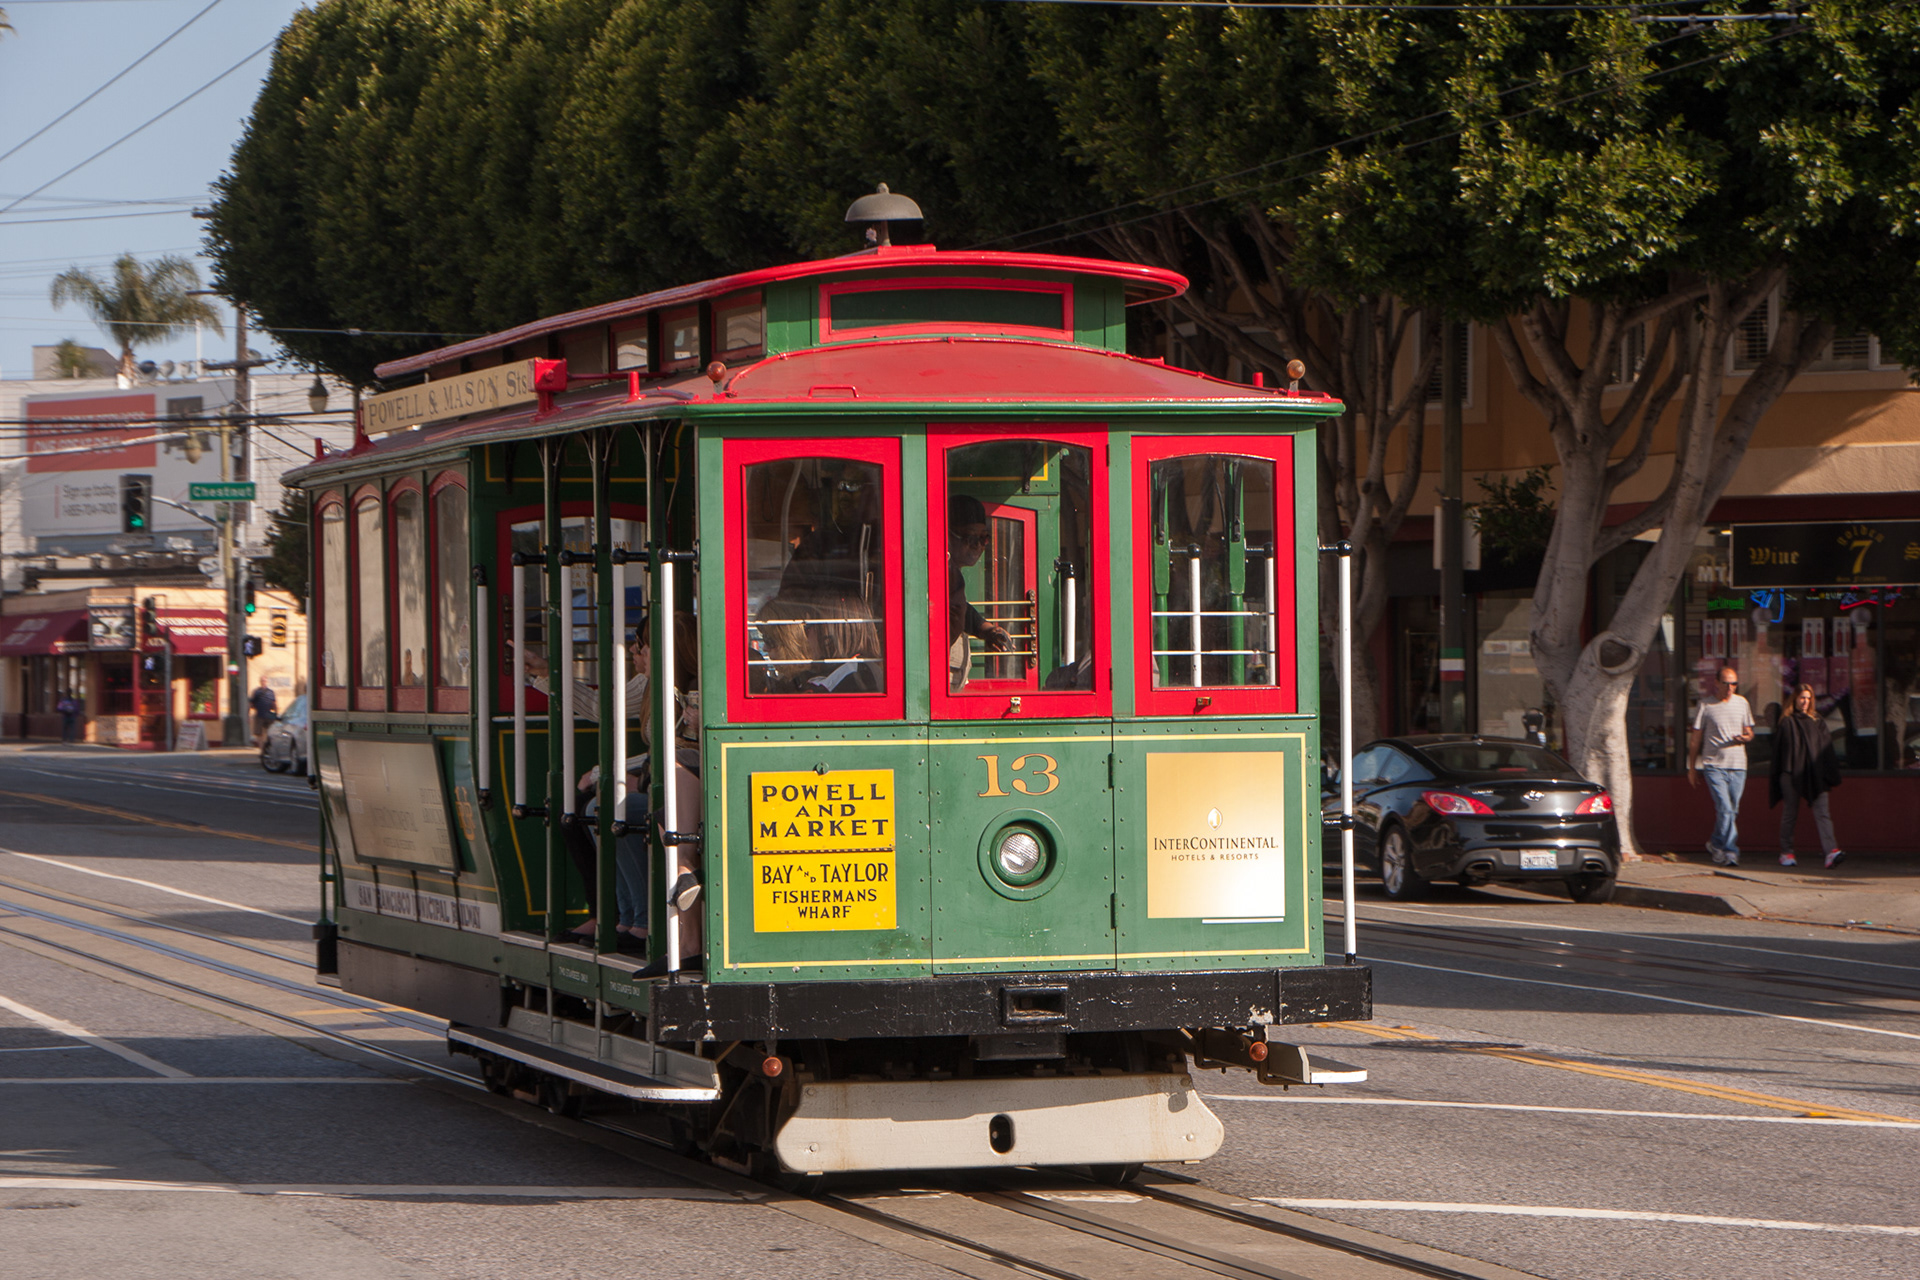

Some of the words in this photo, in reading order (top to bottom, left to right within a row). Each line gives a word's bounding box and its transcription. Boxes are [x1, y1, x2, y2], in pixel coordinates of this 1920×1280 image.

[369, 393, 423, 426] POWELL
[429, 390, 439, 415] &
[443, 375, 499, 412] MASON
[507, 370, 528, 398] Sts
[192, 485, 253, 498] Chestnut
[1750, 547, 1800, 565] Wine
[1850, 539, 1873, 574] 7
[976, 753, 1060, 798] 13
[761, 783, 886, 803] POWELL
[795, 804, 857, 818] AND
[760, 819, 889, 838] MARKET
[1171, 853, 1207, 861] HOTELS
[1210, 853, 1216, 861] &
[1219, 852, 1259, 861] RESORTS
[762, 865, 794, 885] BAY
[796, 865, 817, 883] AND
[820, 863, 889, 883] TAYLOR
[772, 889, 877, 904] FISHERMANS
[798, 905, 852, 919] WHARF
